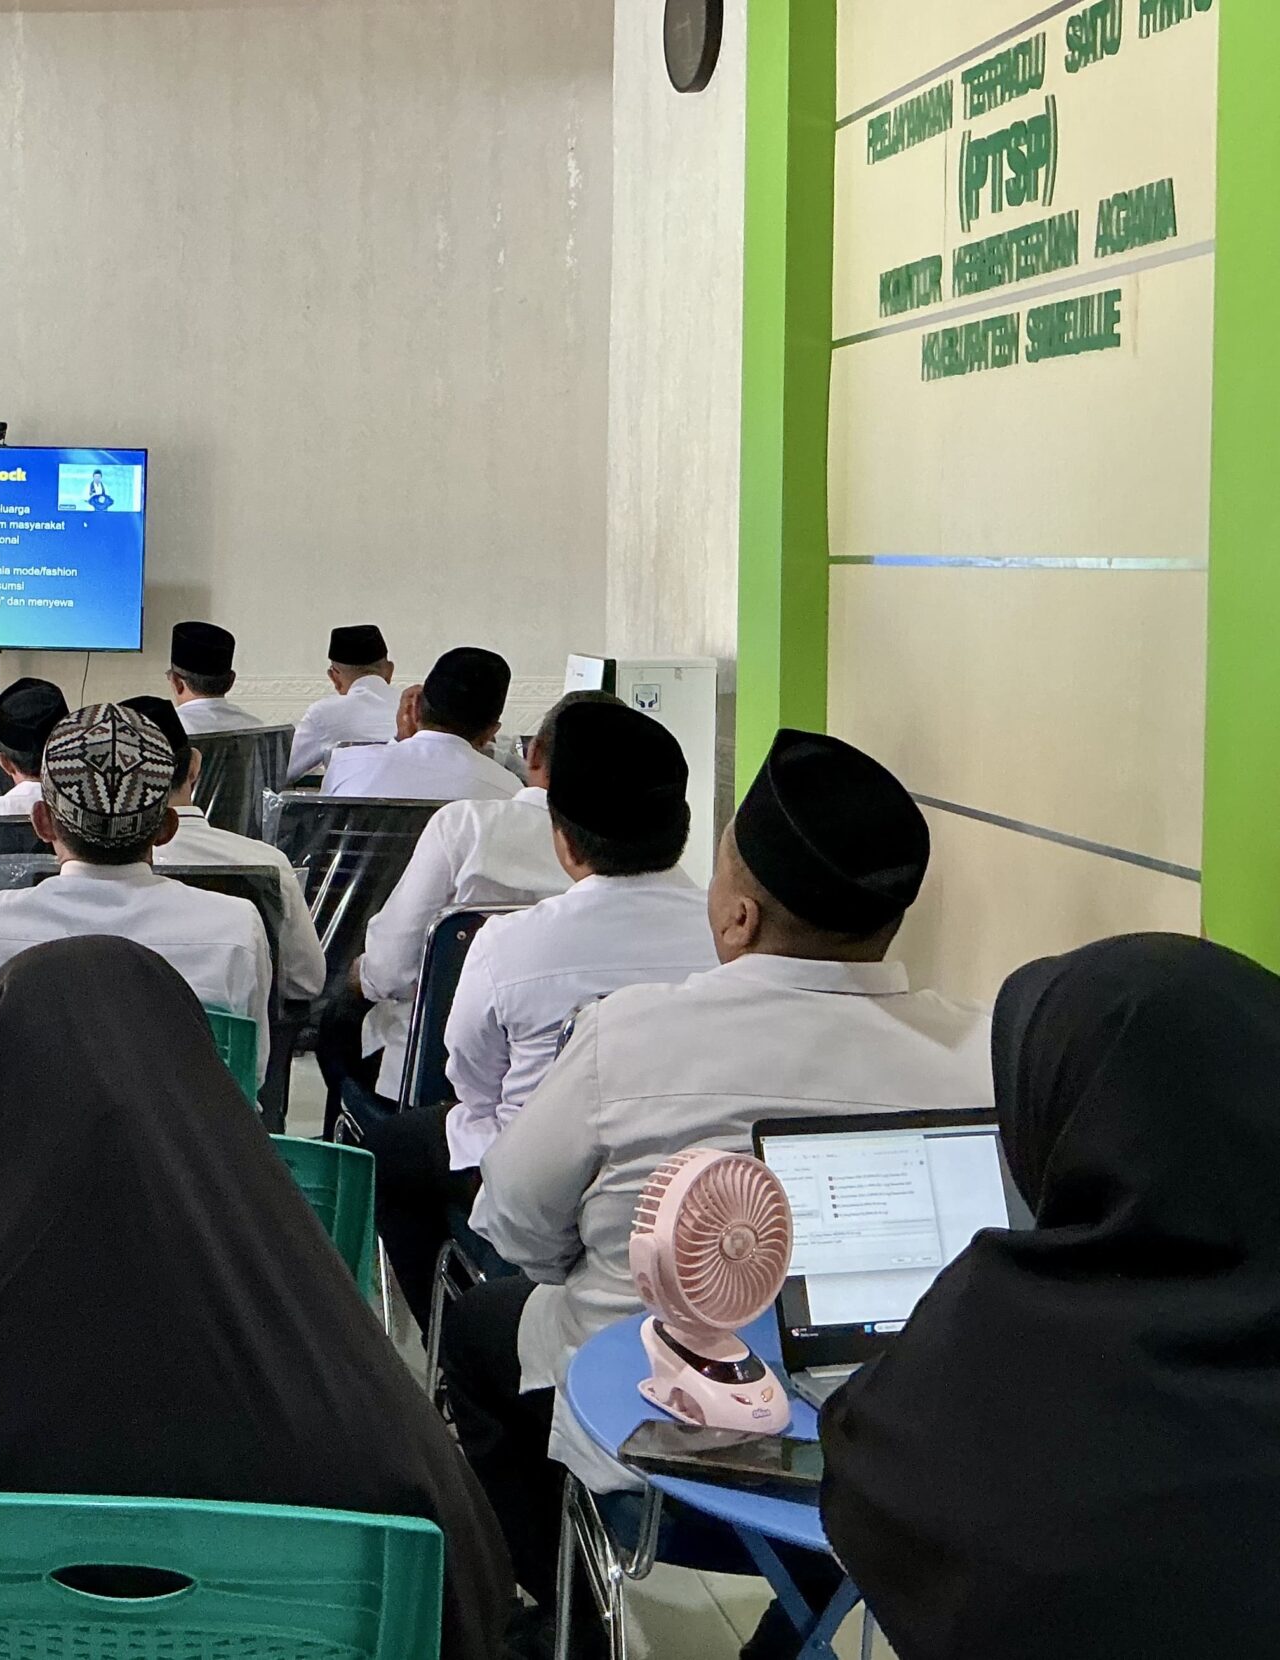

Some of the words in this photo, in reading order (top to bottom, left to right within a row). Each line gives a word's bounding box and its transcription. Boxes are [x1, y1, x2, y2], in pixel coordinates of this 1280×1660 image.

[1064, 0, 1122, 73] SATU
[9, 521, 65, 531] masyarakat
[13, 567, 78, 577] mode/fashion
[6, 597, 25, 606] dan
[27, 599, 74, 609] menyewa
